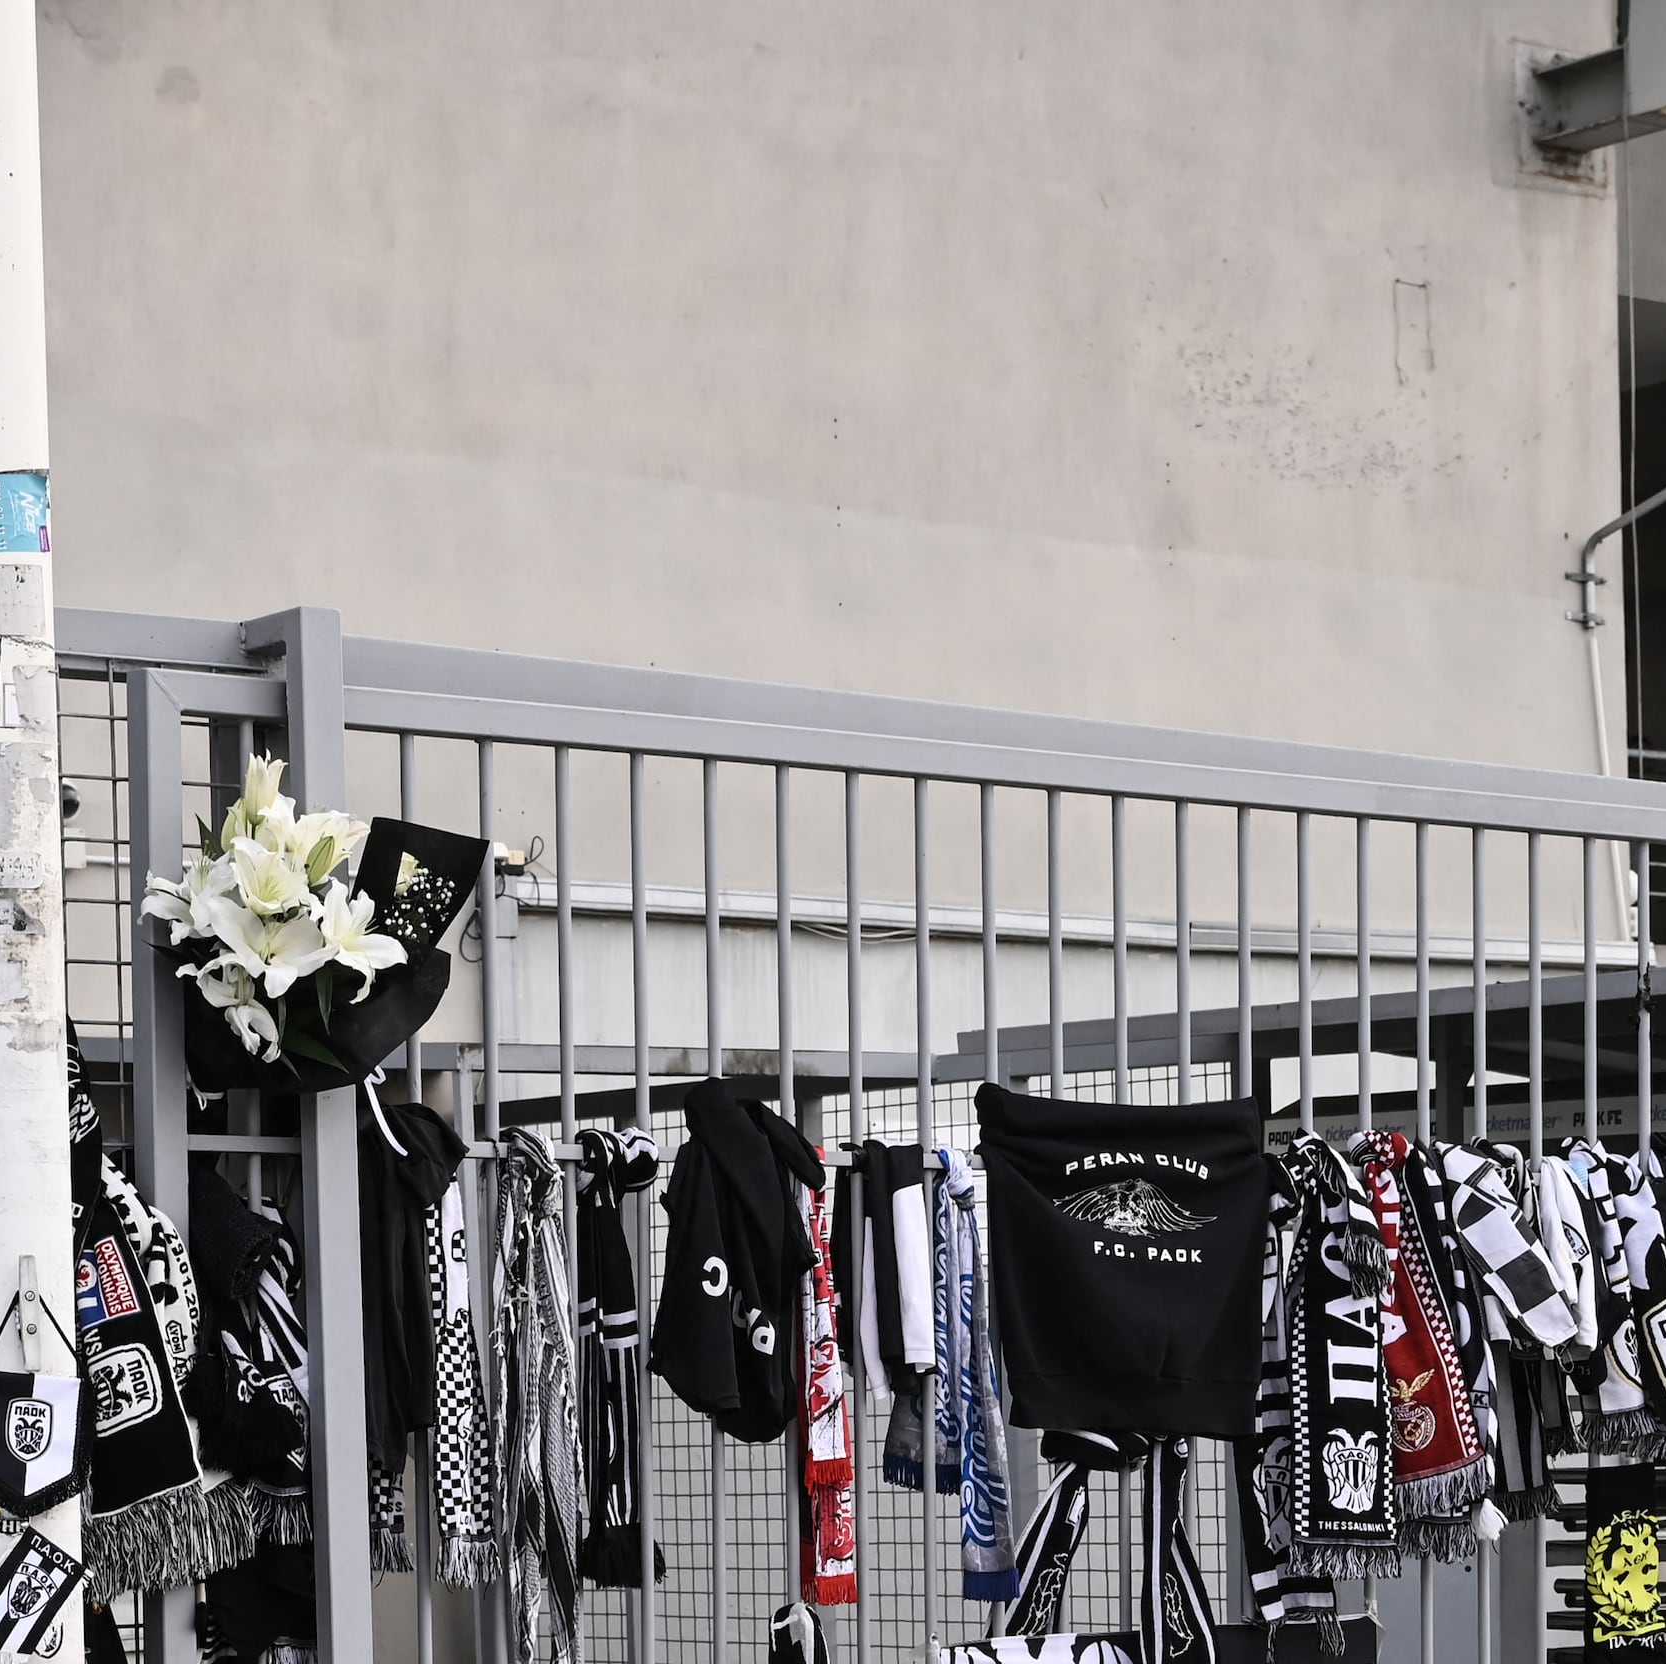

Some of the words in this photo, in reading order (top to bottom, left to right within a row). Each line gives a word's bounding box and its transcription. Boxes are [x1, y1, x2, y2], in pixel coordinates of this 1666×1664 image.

[1607, 1109, 1622, 1124] FC
[1065, 1152, 1145, 1176] PERAN
[1155, 1153, 1209, 1180] CLUB
[1094, 1240, 1135, 1259] F.C.
[1147, 1246, 1203, 1263] PAOK
[96, 1249, 123, 1313] LYONNAIS
[101, 1241, 136, 1311] OLYMPIQUE
[84, 1328, 103, 1356] VS
[126, 1358, 151, 1404] ΠΑΟΚ
[14, 1406, 47, 1418] ΠΑΟΚ
[1337, 1447, 1370, 1464] ΠΑΟΚ
[1318, 1519, 1386, 1533] THESSALONIKI
[31, 1535, 75, 1576] Π.Α.Ο.Κ.
